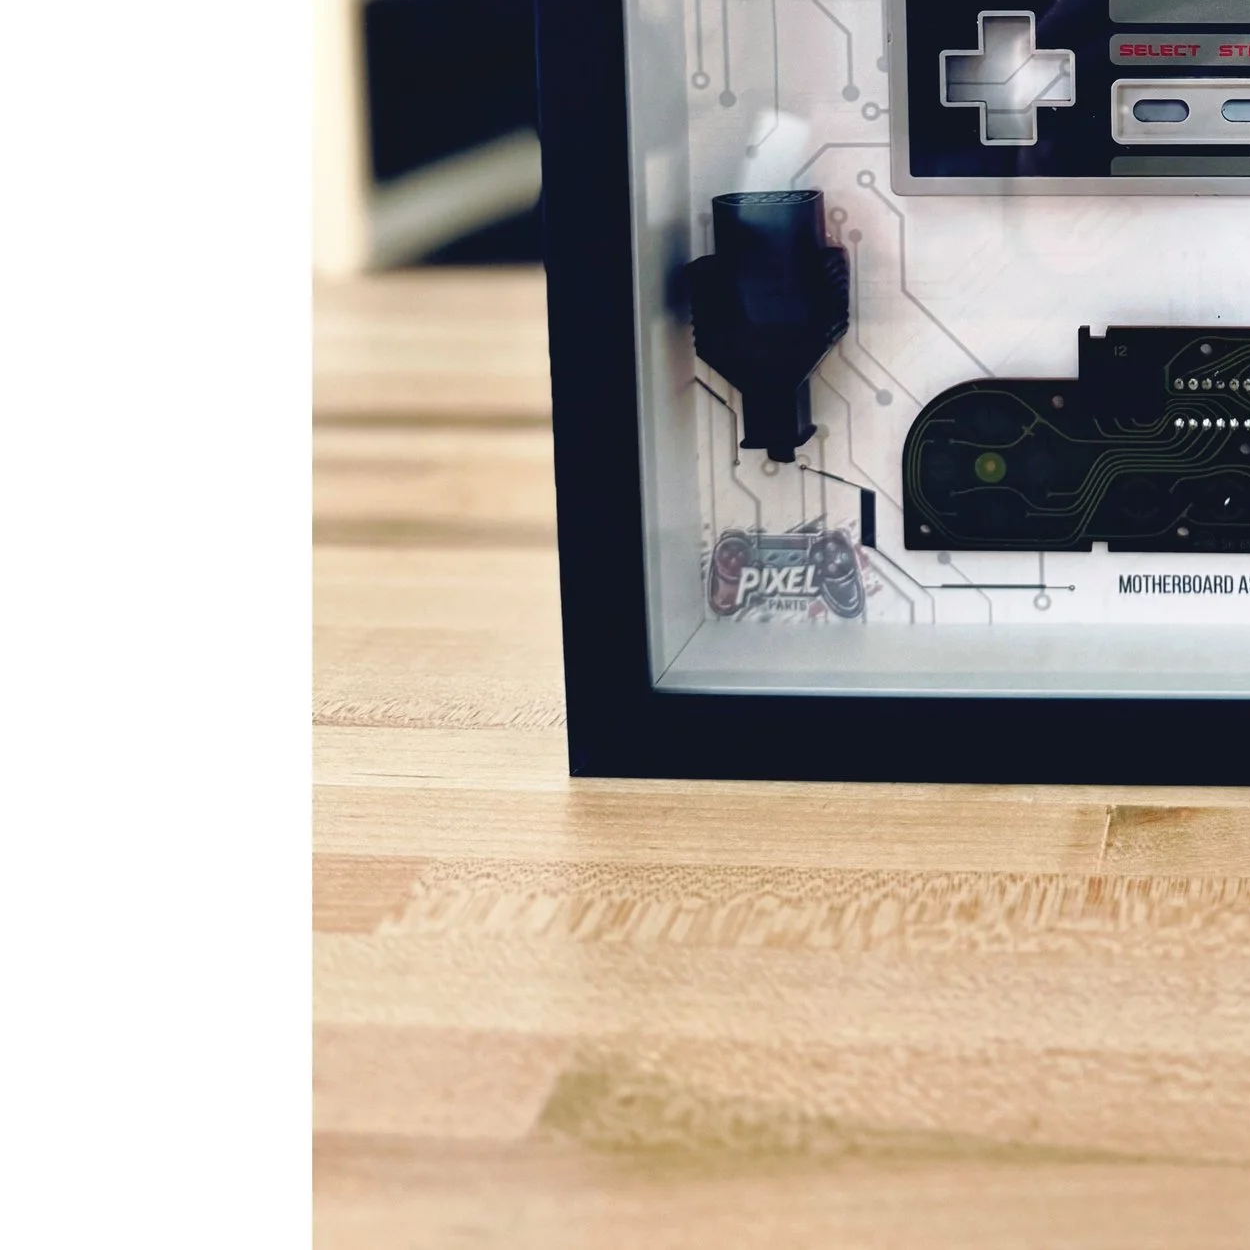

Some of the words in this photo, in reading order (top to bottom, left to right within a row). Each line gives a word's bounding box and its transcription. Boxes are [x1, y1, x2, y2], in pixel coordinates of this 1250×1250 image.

[1119, 44, 1200, 58] SELECT
[736, 564, 820, 605] PIXEL
[1118, 574, 1236, 596] MOTHERBOARD
[769, 599, 807, 611] PARTS
